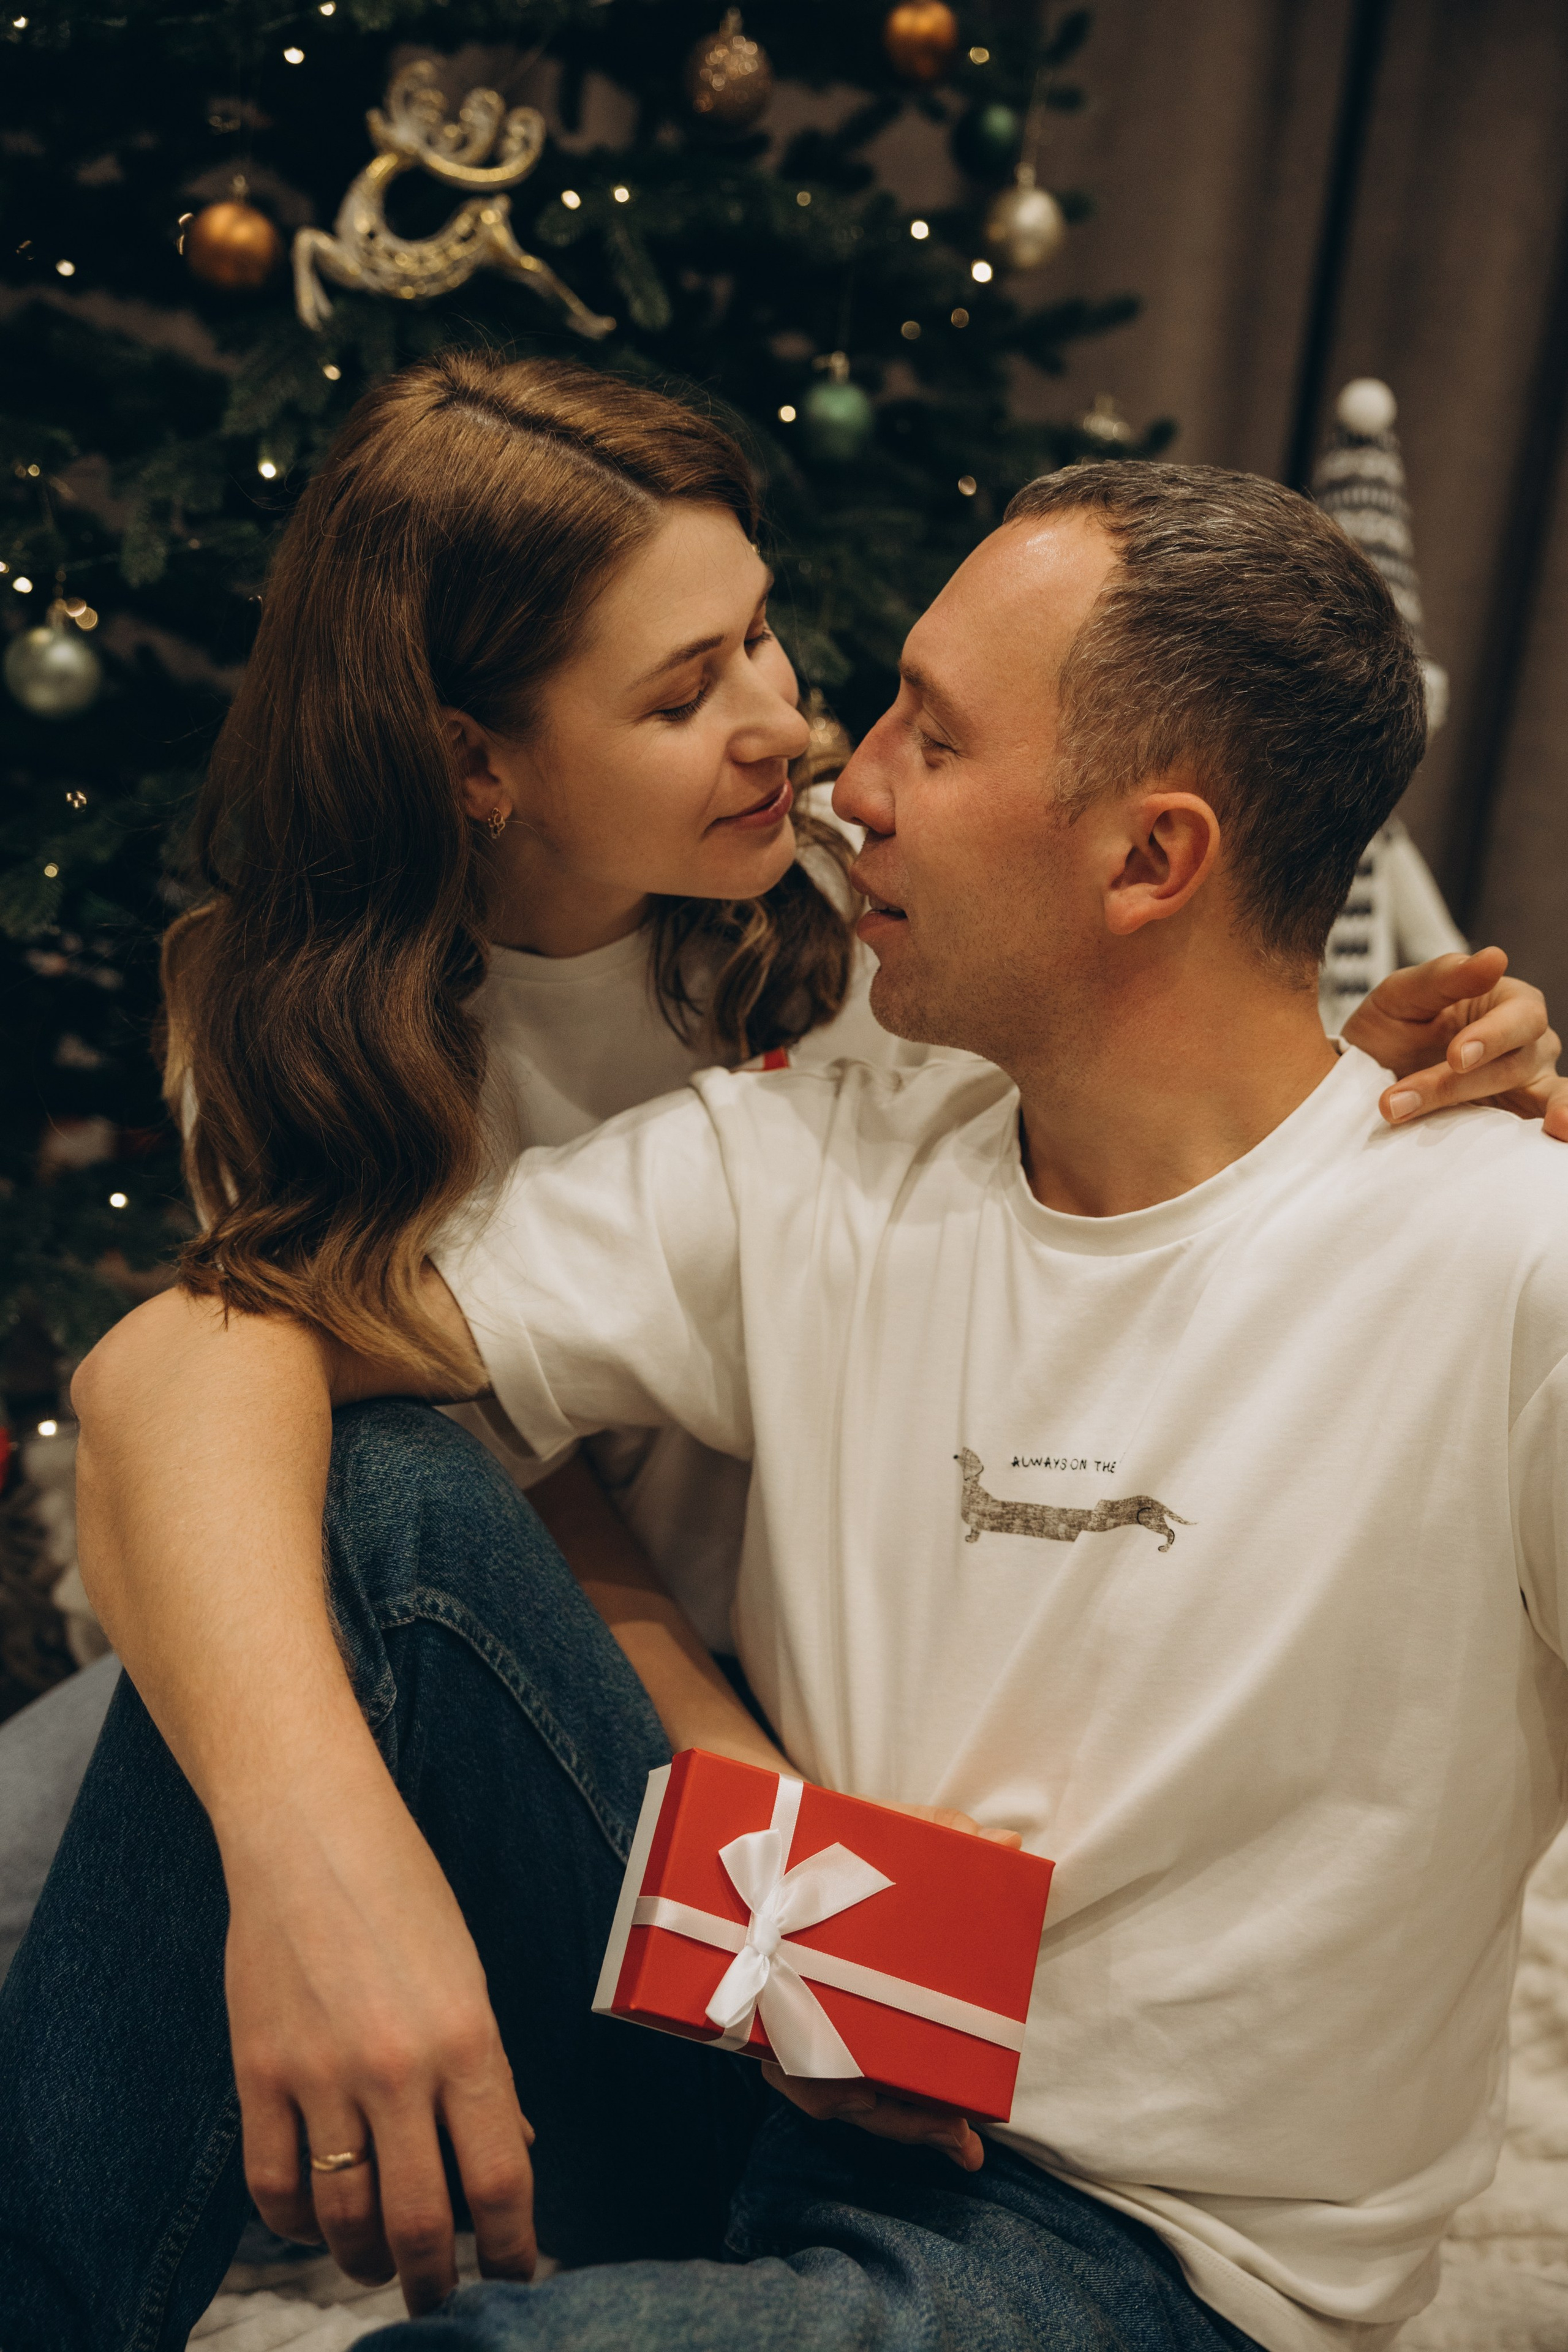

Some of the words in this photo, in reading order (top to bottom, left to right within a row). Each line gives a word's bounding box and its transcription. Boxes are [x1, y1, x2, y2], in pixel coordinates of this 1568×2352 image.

[1011, 1455, 1067, 1470] ALWAYS
[1069, 1458, 1087, 1470] ON
[1094, 1460, 1117, 1473] THE
